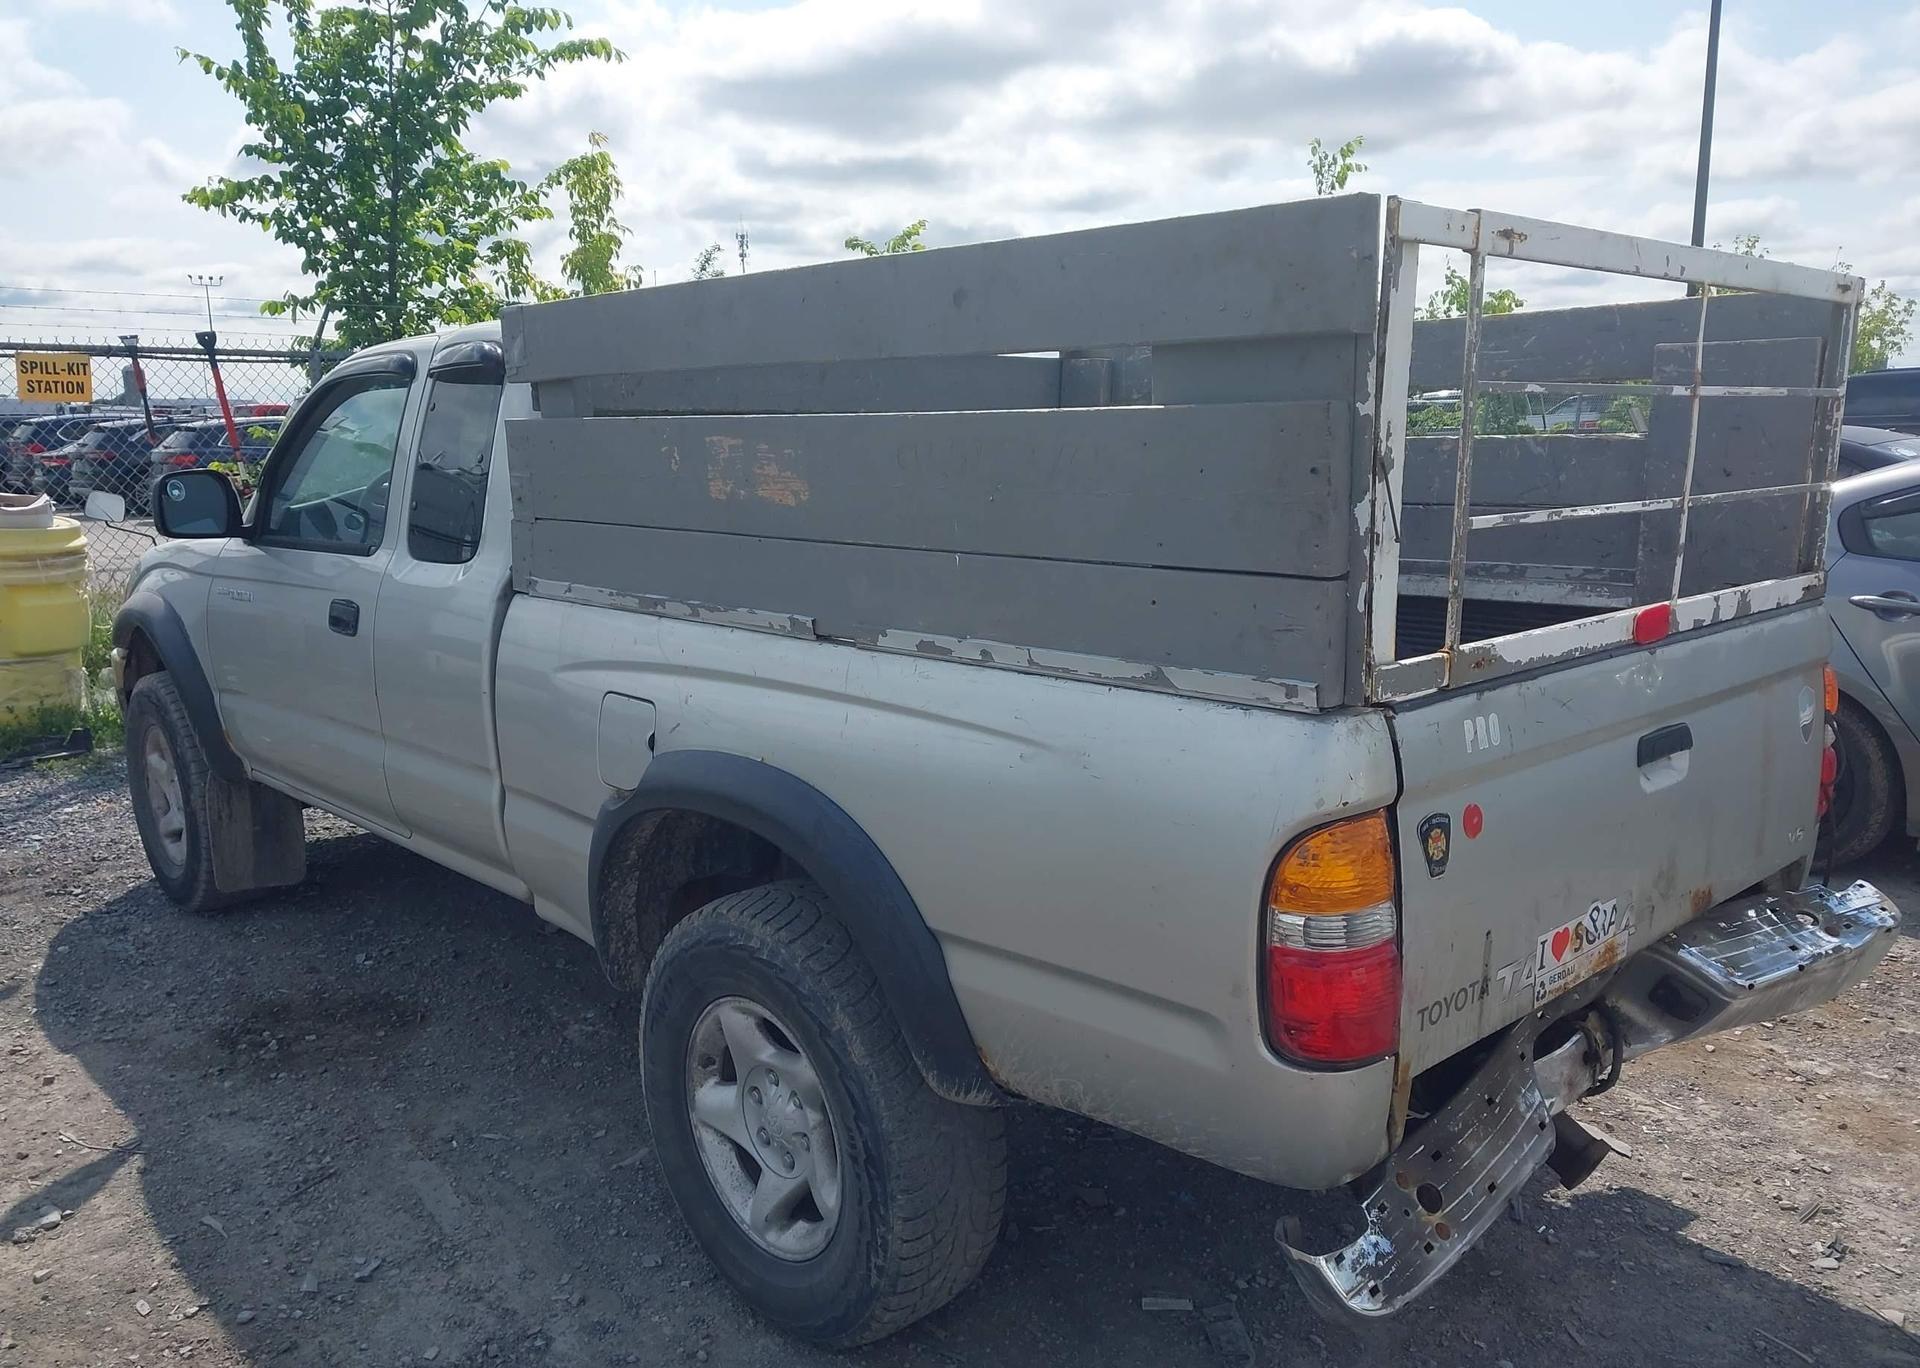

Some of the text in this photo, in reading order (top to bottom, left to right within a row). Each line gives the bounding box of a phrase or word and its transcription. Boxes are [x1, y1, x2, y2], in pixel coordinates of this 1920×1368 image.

[19, 360, 89, 376] SPILL-KIT
[26, 379, 85, 394] STATION
[1463, 712, 1501, 754] PRO
[1537, 938, 1548, 972] I
[1548, 964, 1576, 985] GERDAU
[1416, 976, 1491, 1033] TOYOTA
